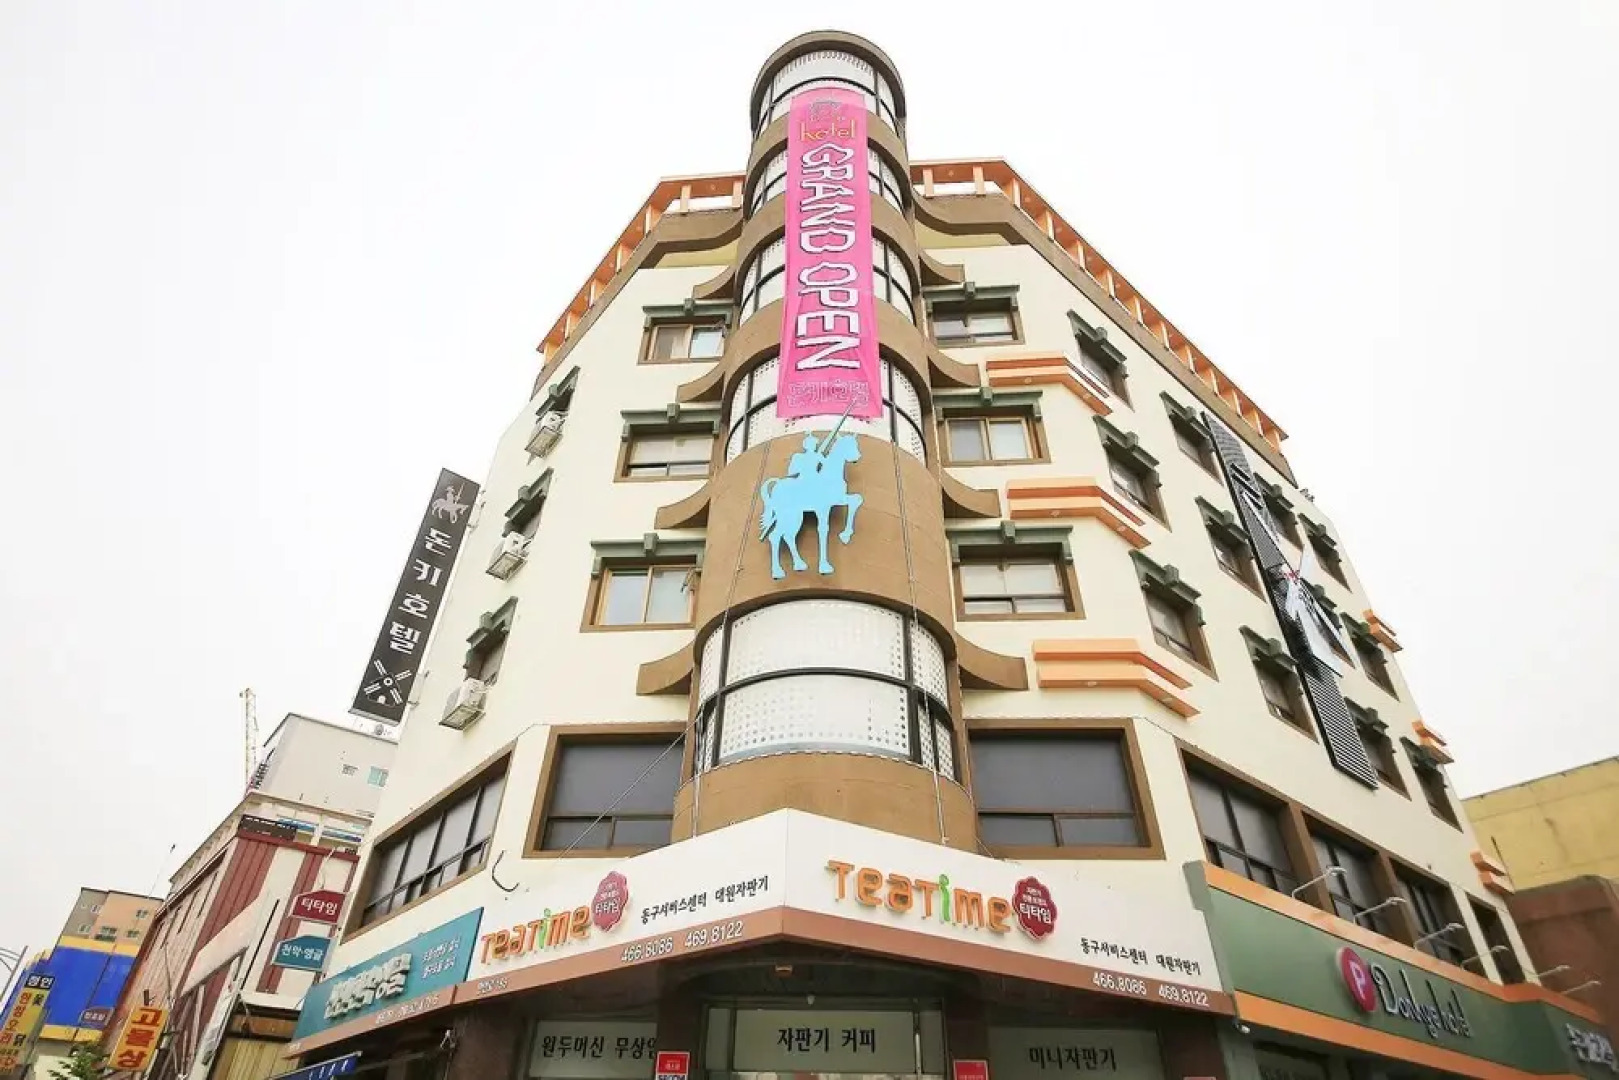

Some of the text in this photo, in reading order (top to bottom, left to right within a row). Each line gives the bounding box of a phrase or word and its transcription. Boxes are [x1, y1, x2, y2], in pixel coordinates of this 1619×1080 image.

[796, 143, 860, 371] GRAND OPEN
[390, 527, 453, 655] 돈키호텔
[301, 898, 338, 916] 티타임
[641, 875, 769, 925] 동구서비스센터 대원자판기
[1020, 902, 1053, 925] 티타임
[684, 920, 743, 948] 469.8122
[1080, 937, 1201, 976] 동구서비스센터 대원자판기
[1092, 972, 1210, 1008] 466.8086 469.8122
[542, 1035, 605, 1059] 원두머신
[777, 1027, 876, 1054] 자판기 커피
[1029, 1046, 1118, 1072] 미니자판기
